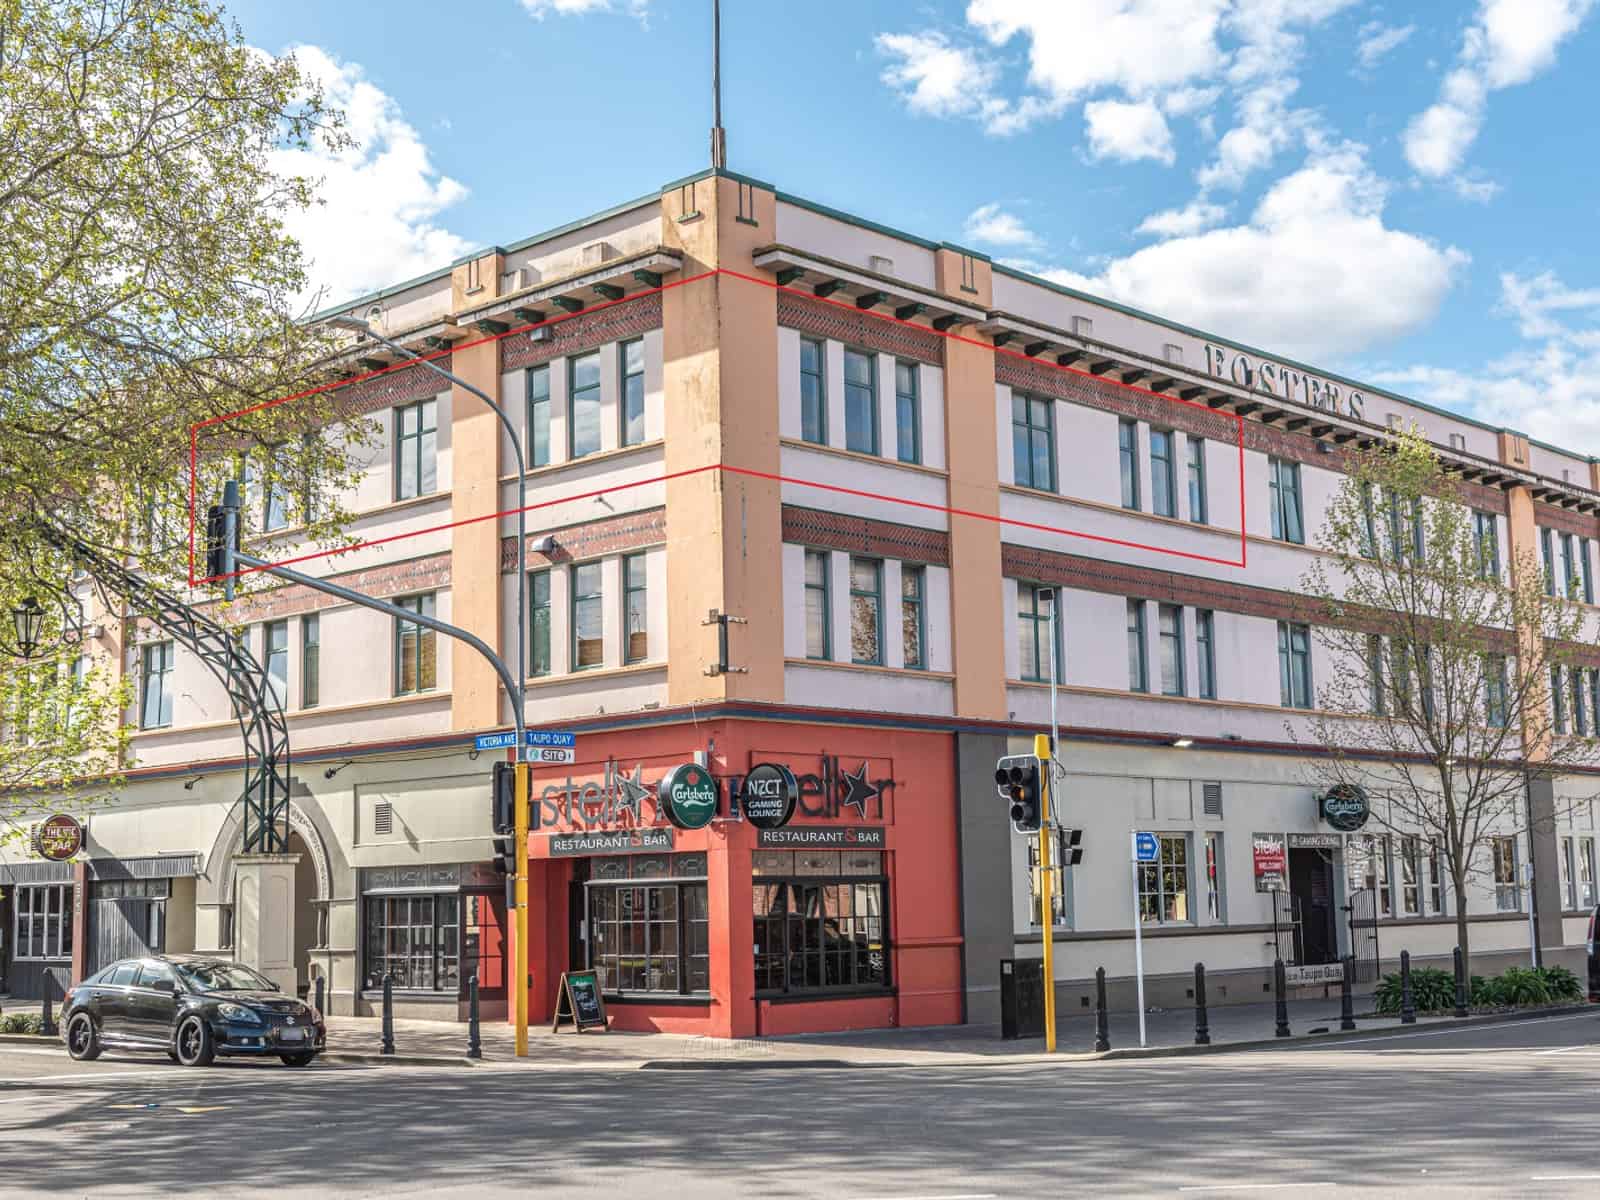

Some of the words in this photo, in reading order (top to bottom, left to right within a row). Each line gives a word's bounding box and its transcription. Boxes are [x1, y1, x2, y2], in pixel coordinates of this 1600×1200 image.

[479, 736, 502, 747] VICTORIA
[503, 734, 515, 744] AVE
[529, 733, 551, 744] TAUPO
[552, 735, 572, 745] QUAY
[748, 779, 782, 798] NZCT
[672, 783, 714, 807] Carlsberg
[748, 800, 782, 808] GAMING
[748, 809, 782, 817] LOUNGE
[554, 836, 629, 850] RESTAURANT
[643, 834, 667, 846] BAR
[763, 831, 843, 843] RESTAURANT
[858, 832, 880, 843] BAR
